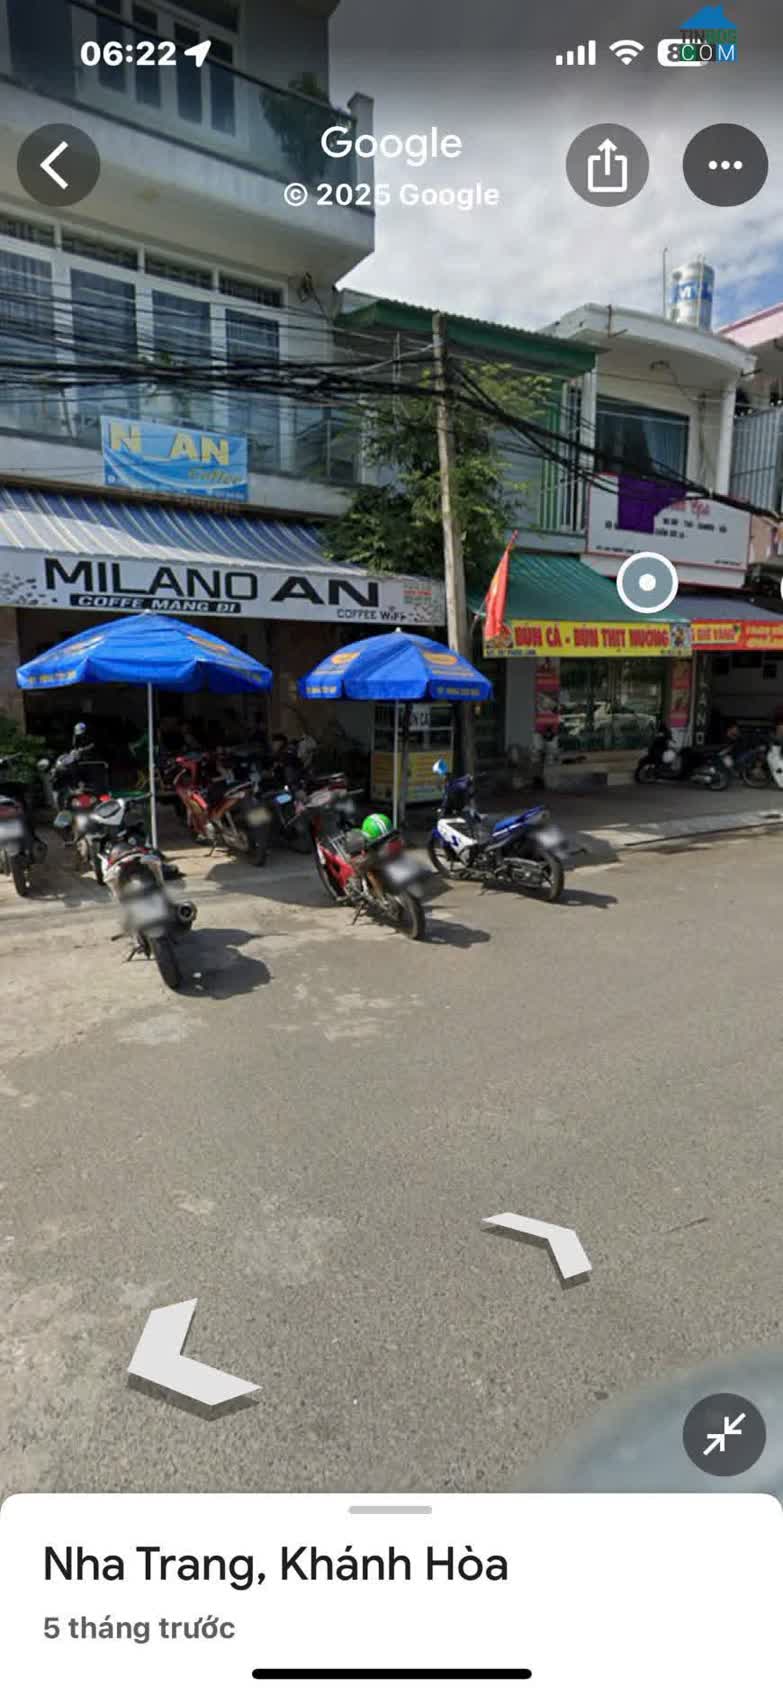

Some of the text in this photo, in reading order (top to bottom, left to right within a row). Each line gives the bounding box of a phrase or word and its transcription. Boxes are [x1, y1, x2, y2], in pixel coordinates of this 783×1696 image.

[169, 432, 230, 465] AN
[44, 558, 259, 600] MILANO
[271, 576, 379, 607] AN
[78, 596, 143, 609] COFFE
[151, 599, 209, 612] MANG
[336, 608, 377, 620] COFFEE
